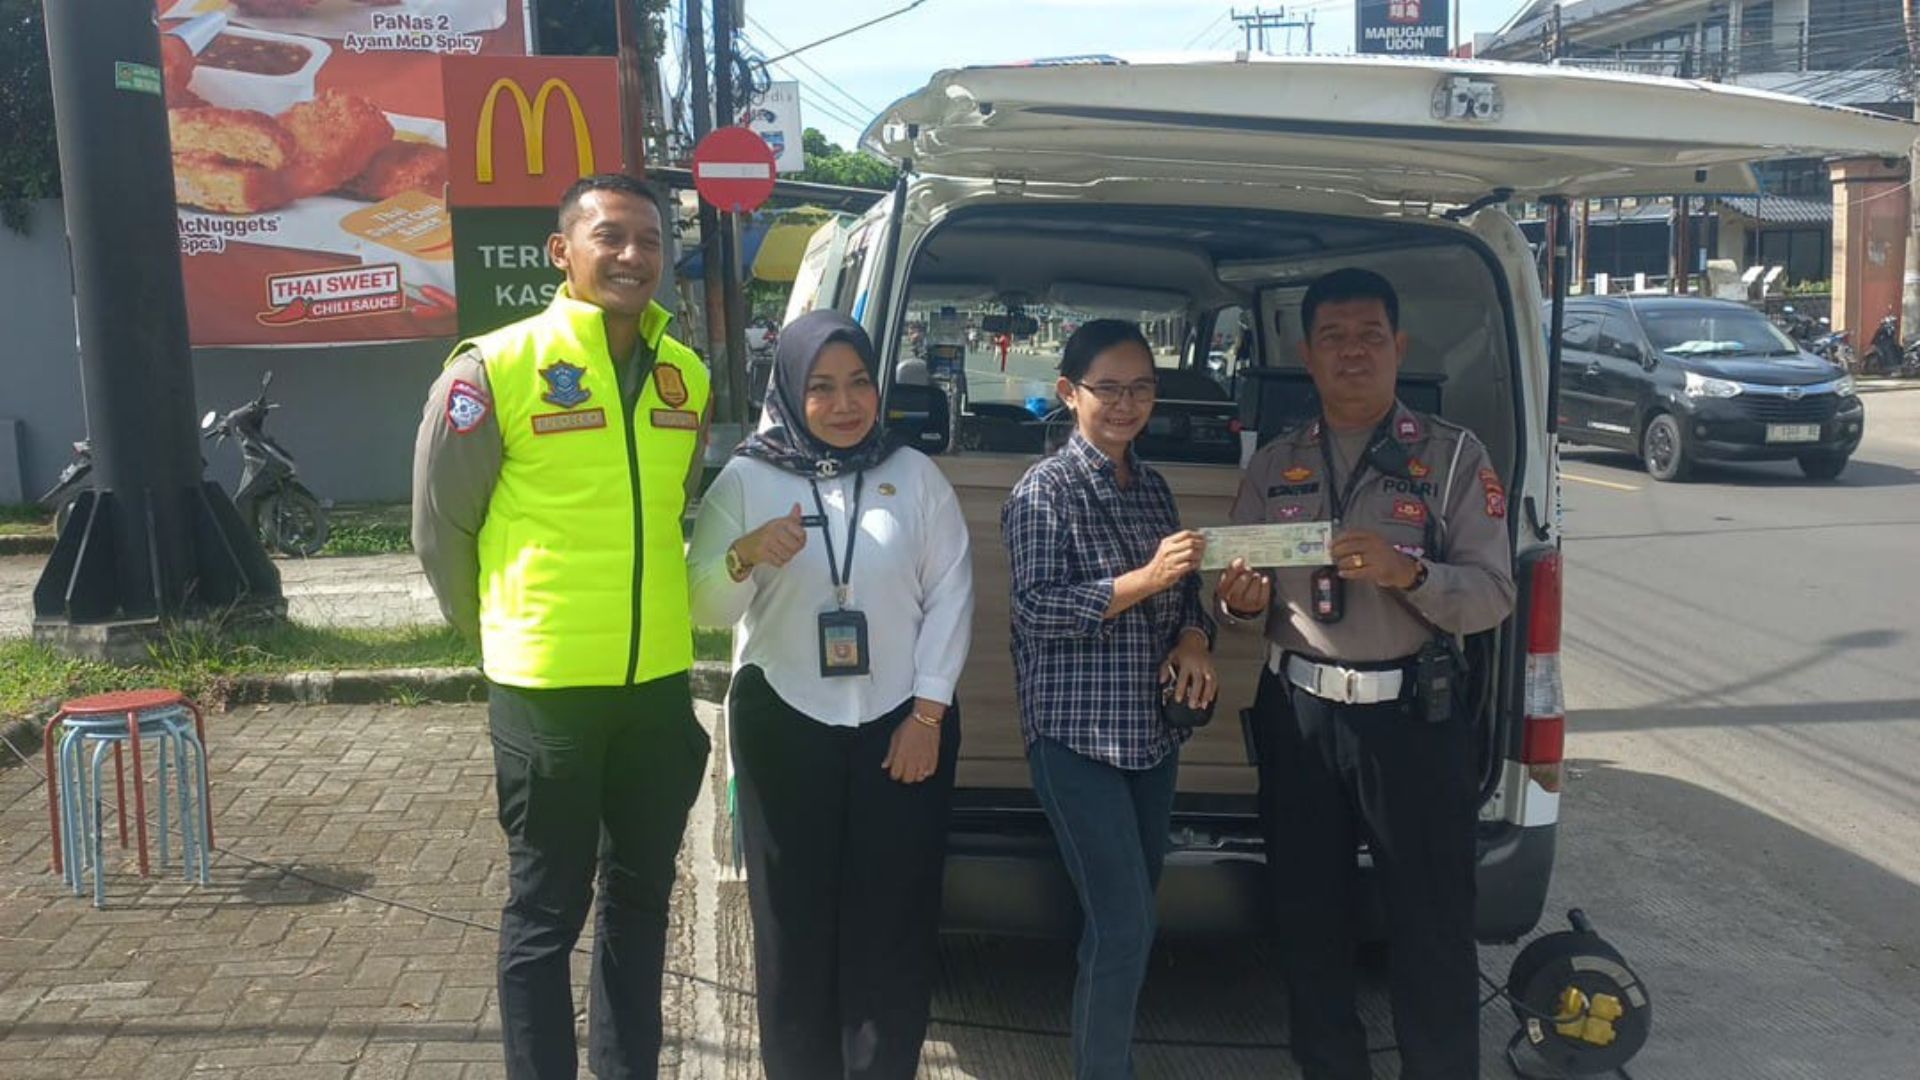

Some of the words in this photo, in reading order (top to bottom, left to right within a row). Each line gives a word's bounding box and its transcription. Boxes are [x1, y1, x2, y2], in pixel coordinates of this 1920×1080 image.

[372, 13, 434, 31] PaNas
[437, 14, 449, 31] 2
[1364, 25, 1445, 39] MARUGAME
[344, 34, 393, 51] Ayam
[396, 34, 433, 48] McD
[436, 34, 481, 52] Spicy
[1386, 36, 1425, 51] UDON
[477, 245, 551, 269] TERI
[273, 279, 323, 299] THAI
[326, 270, 396, 293] SWEET
[495, 283, 557, 307] KAS
[312, 300, 349, 316] CHILI
[351, 295, 399, 312] SAUCE
[1383, 478, 1440, 499] POLRI
